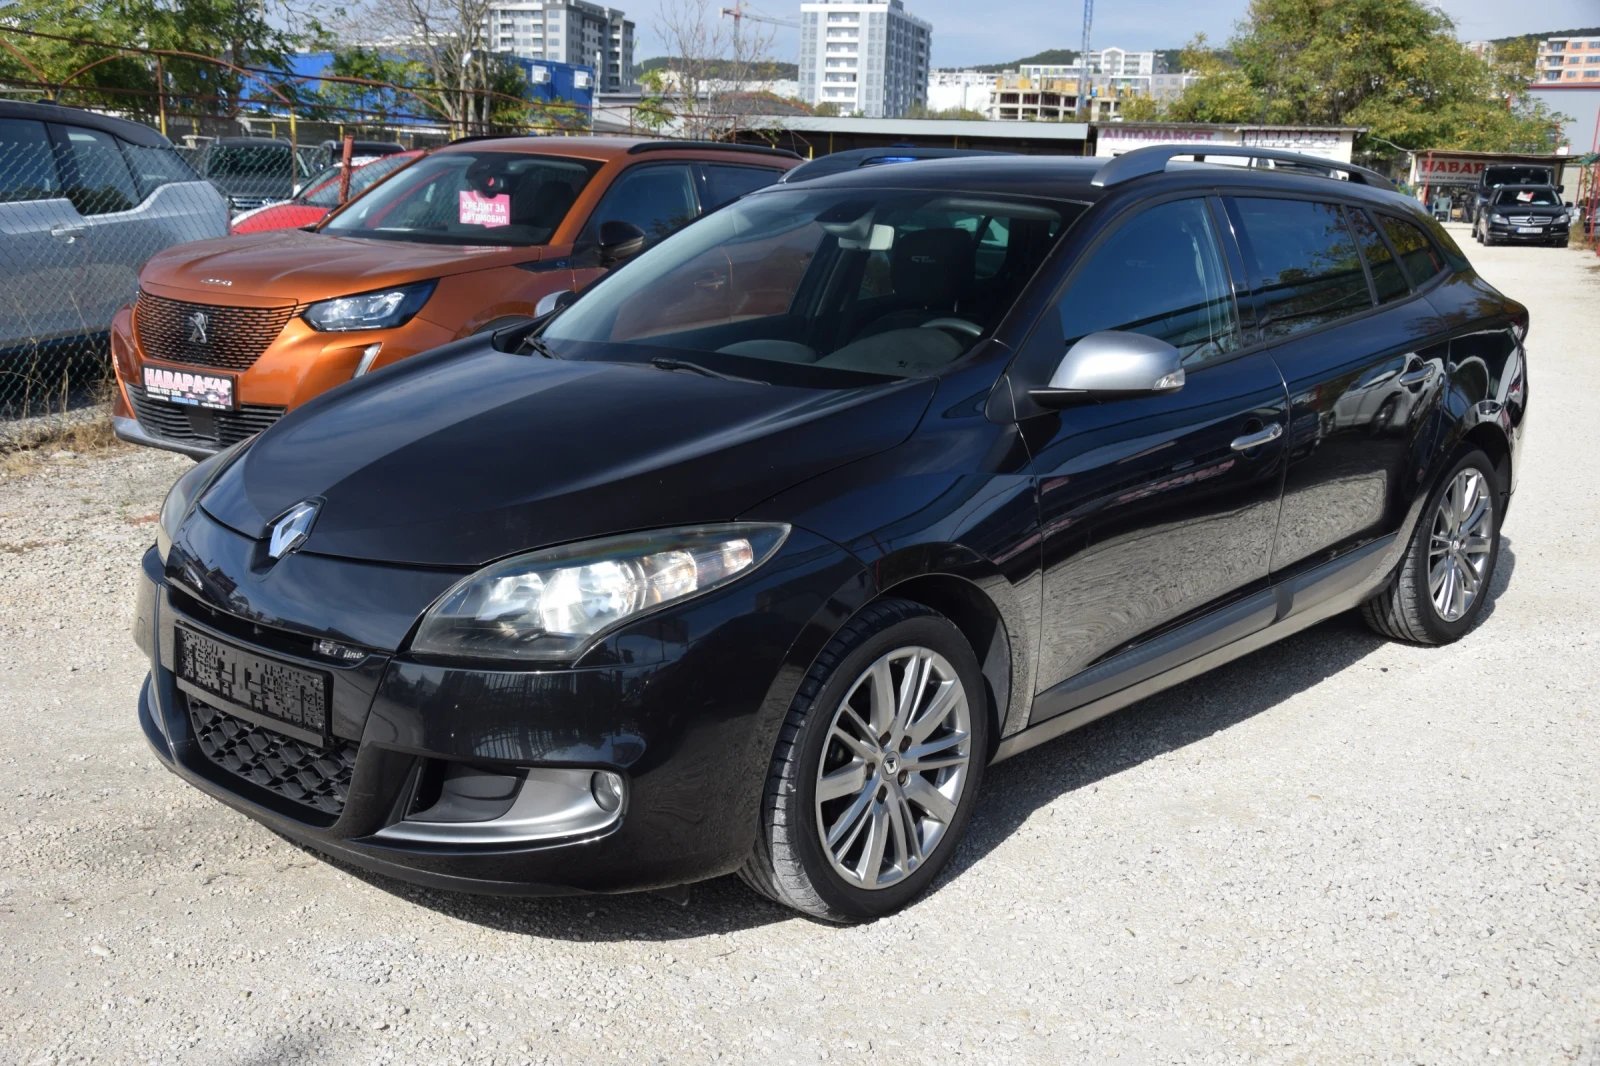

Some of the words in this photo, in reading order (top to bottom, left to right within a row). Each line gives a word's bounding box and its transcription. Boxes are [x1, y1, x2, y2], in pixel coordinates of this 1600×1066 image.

[1101, 127, 1215, 142] AUTOMARKET
[462, 201, 494, 213] КРЕДИТ
[495, 203, 506, 213] ЗА
[462, 211, 507, 224] АВТОМОБИЛ
